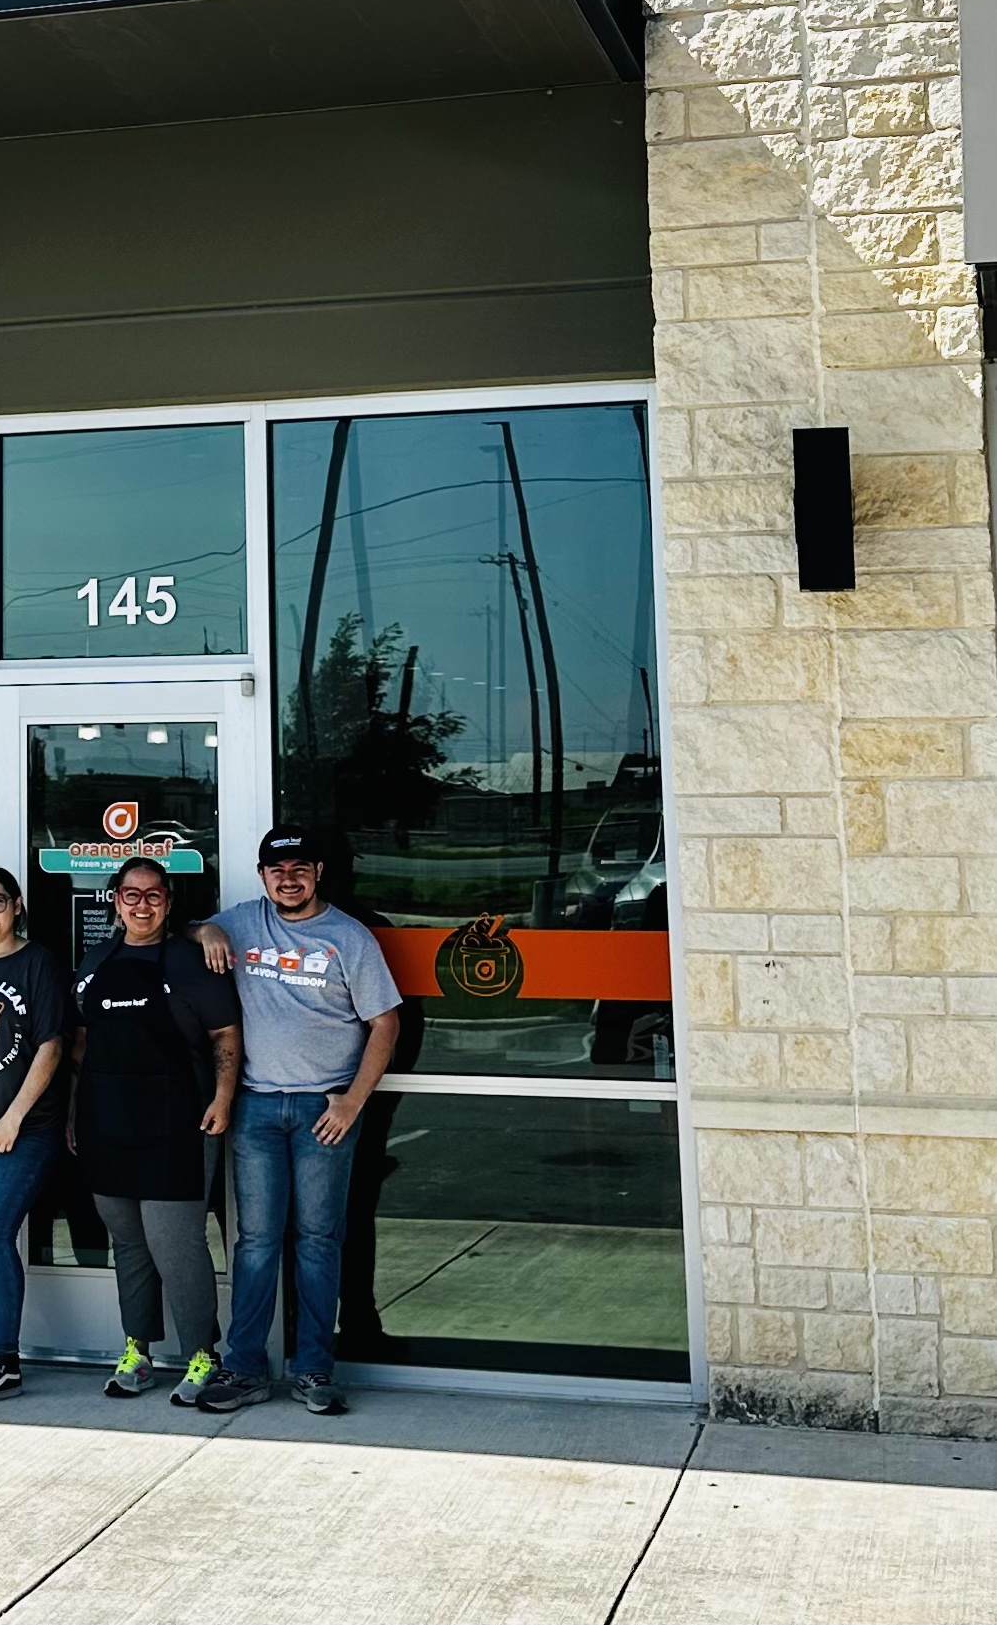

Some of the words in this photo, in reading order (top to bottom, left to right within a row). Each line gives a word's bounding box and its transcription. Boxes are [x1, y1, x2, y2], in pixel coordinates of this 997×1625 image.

[76, 575, 177, 627] 145
[69, 842, 134, 859] orange
[136, 838, 174, 857] leaf
[245, 965, 279, 979] FLAVOR
[279, 973, 327, 988] FREEDOM
